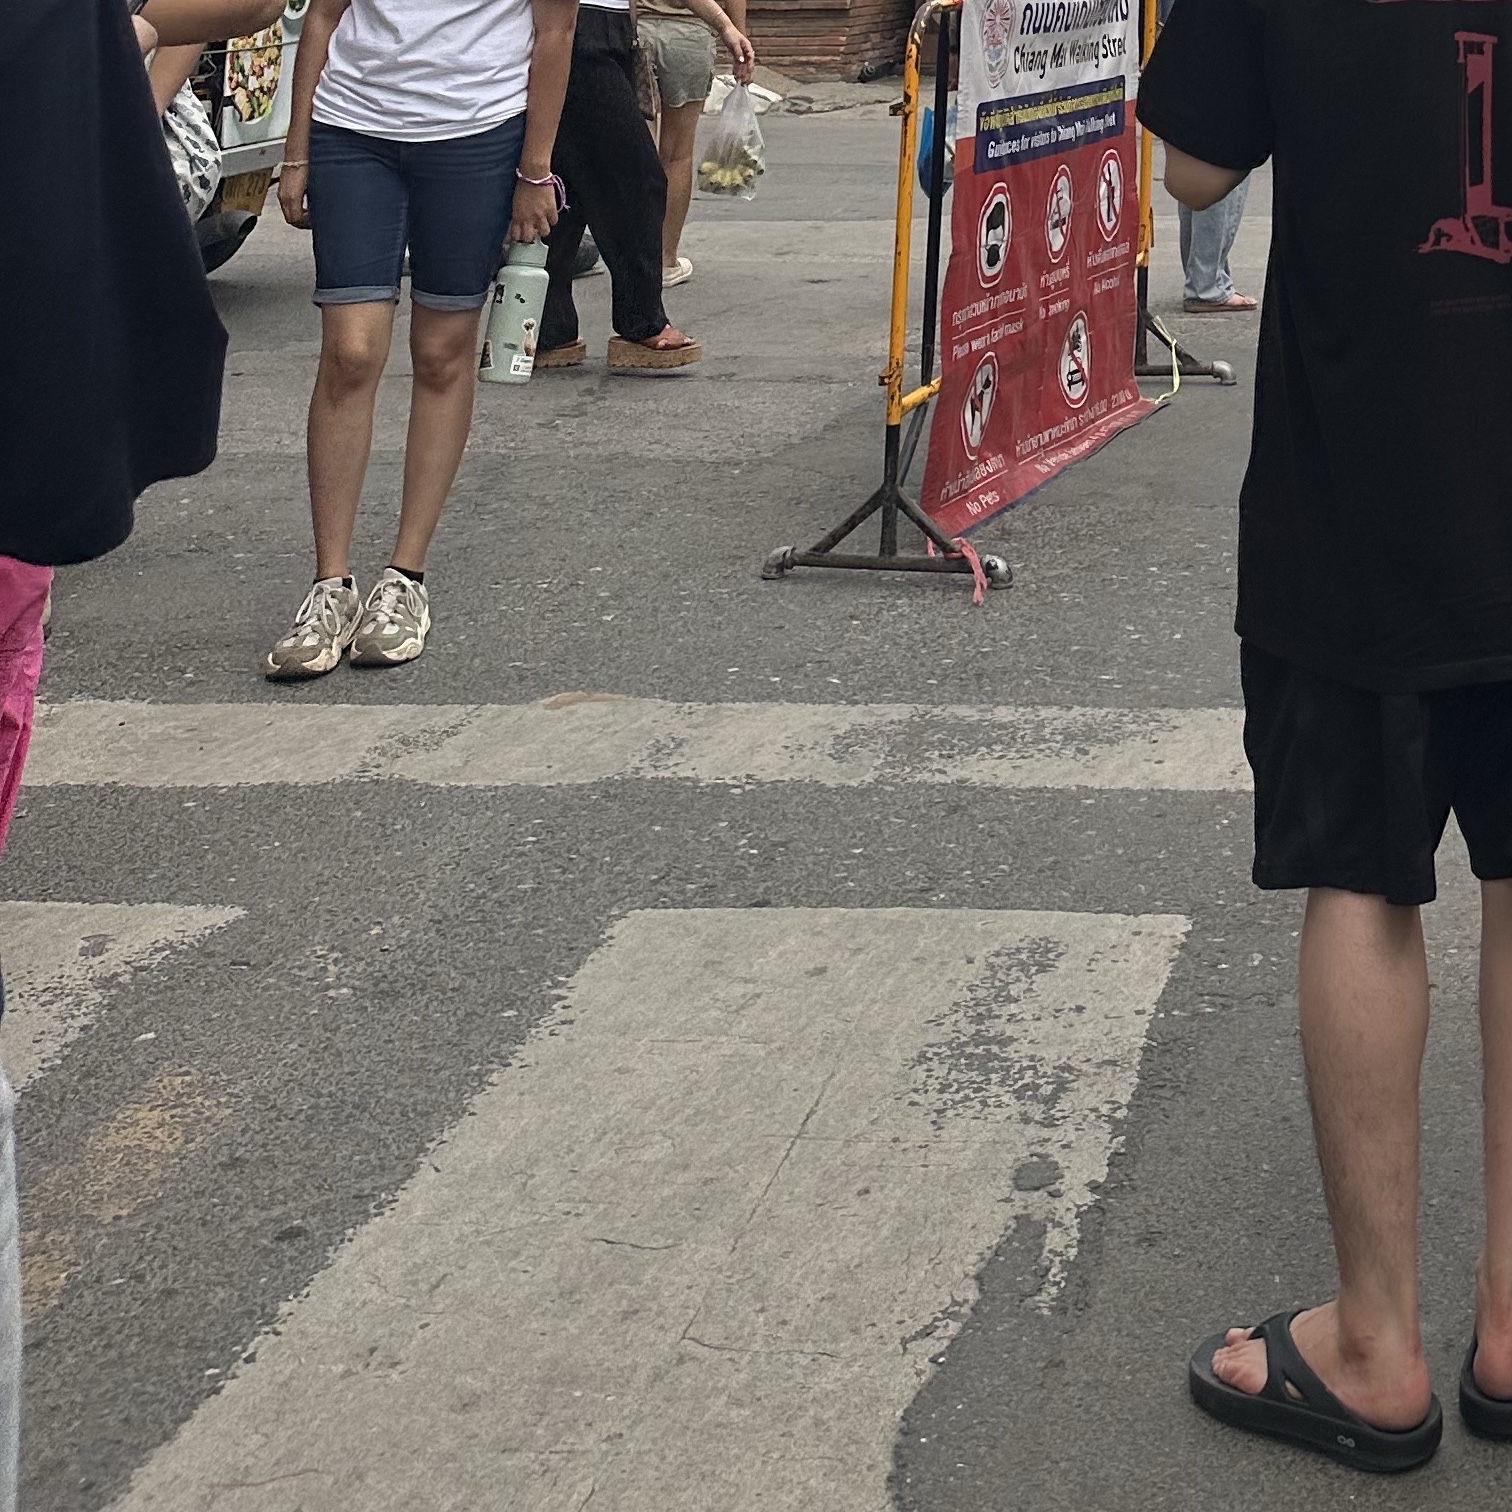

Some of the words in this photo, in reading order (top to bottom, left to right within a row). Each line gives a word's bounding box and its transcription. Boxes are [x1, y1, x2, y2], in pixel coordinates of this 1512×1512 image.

[1014, 43, 1049, 80] Chiang
[966, 501, 982, 516] No
[978, 490, 1000, 509] Pets
